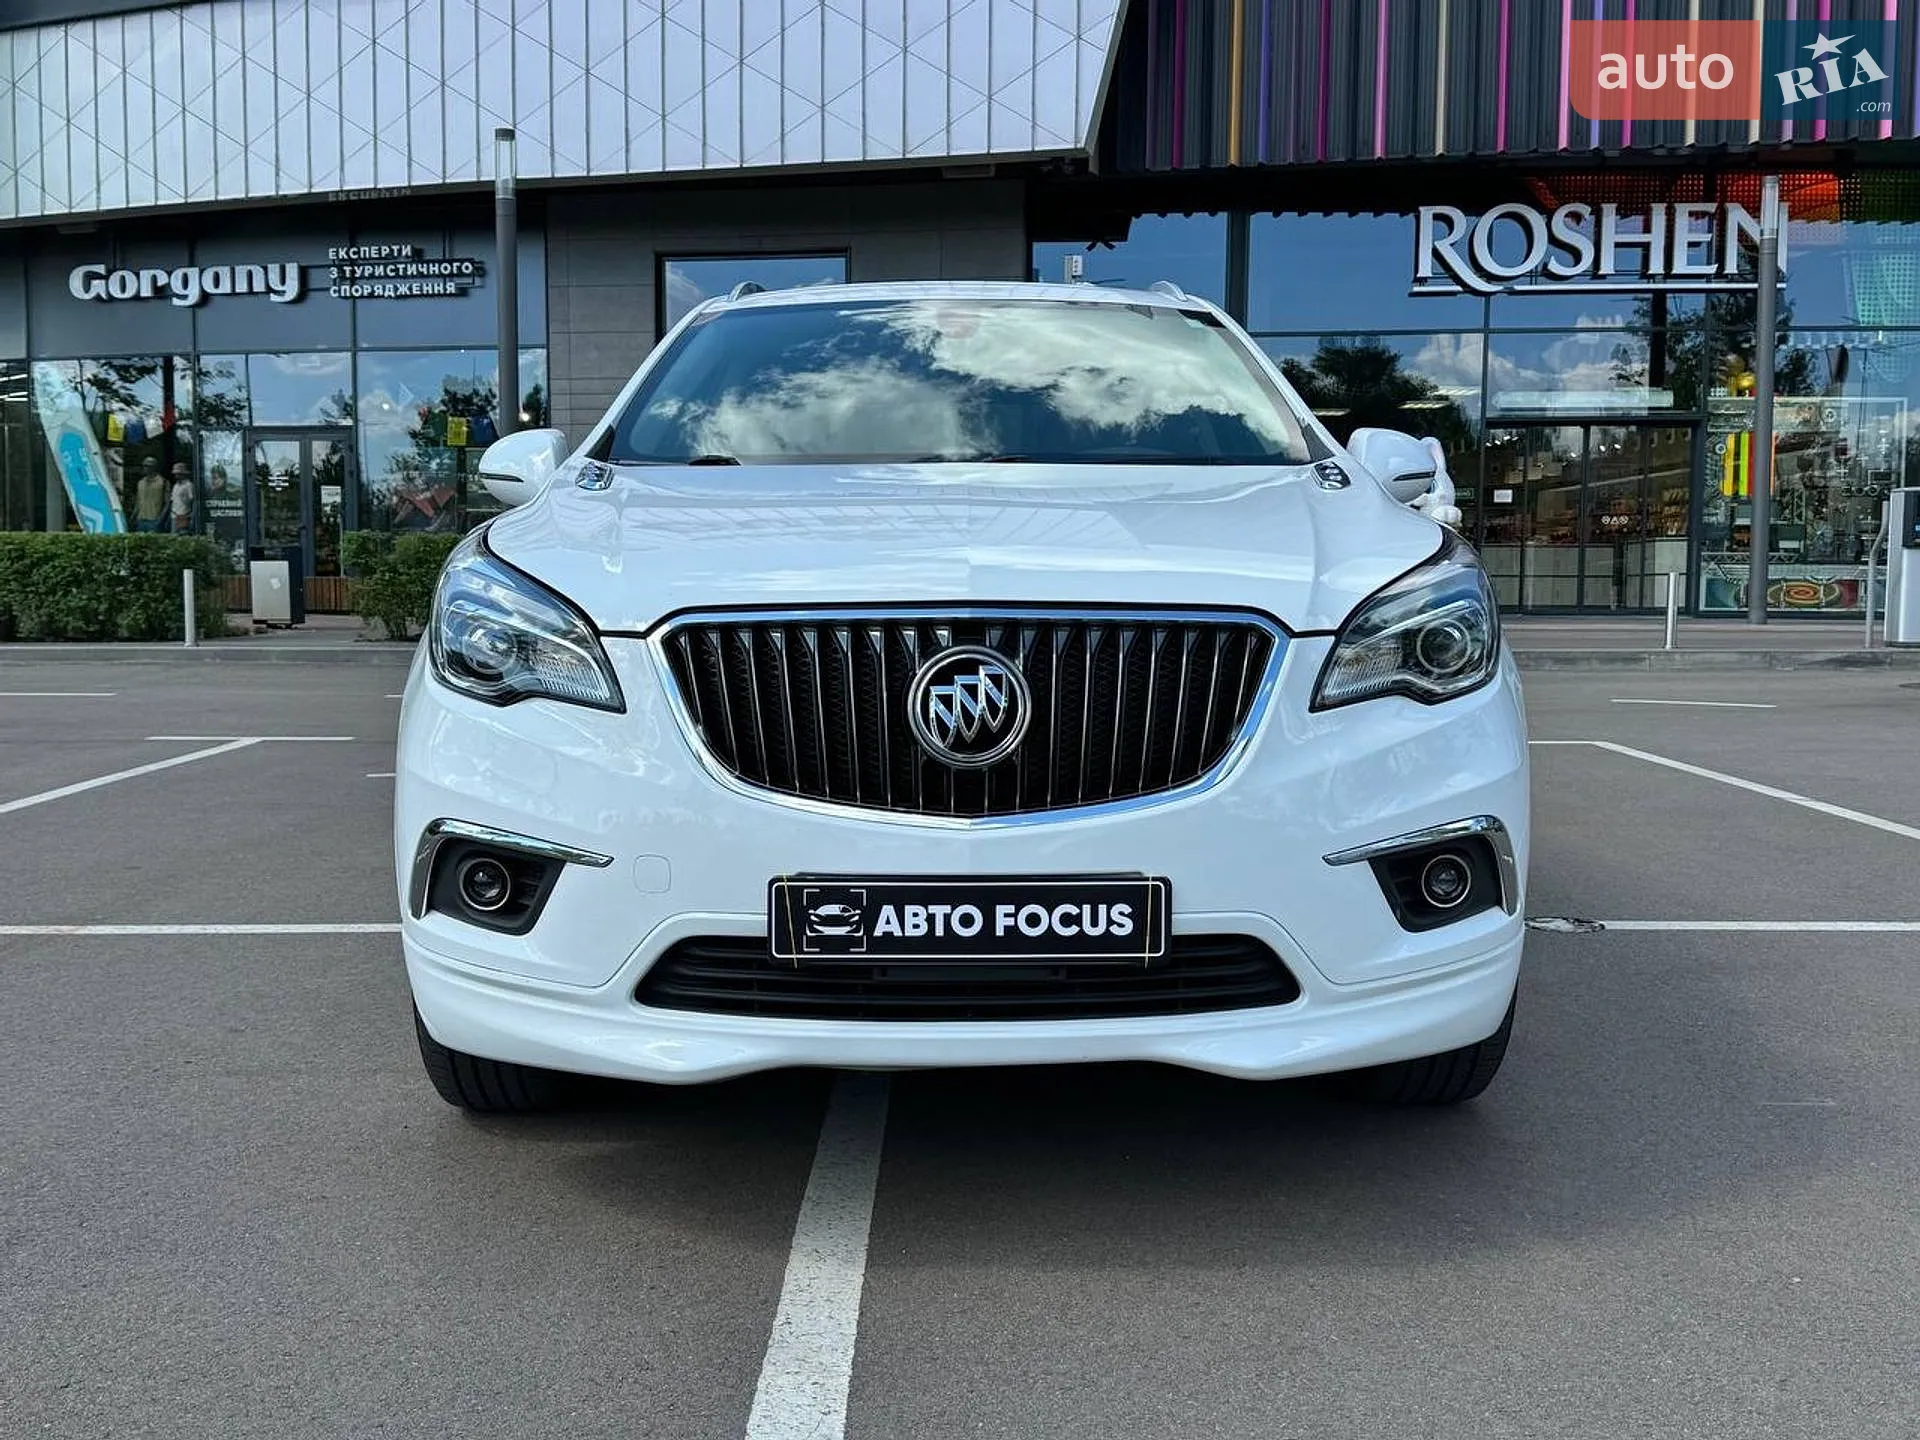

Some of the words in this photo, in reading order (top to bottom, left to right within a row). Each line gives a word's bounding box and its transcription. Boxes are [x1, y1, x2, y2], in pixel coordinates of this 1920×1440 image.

[328, 244, 413, 260] ЕКСПЕРТИ
[1416, 202, 1790, 292] ROSHEN
[343, 262, 474, 278] ТУРИСТИЧНОГО
[68, 262, 301, 308] Gorgany
[329, 282, 457, 298] СПОРЯДЖЕННЯ
[873, 904, 984, 938] АВТО
[995, 903, 1135, 937] FOCUS
